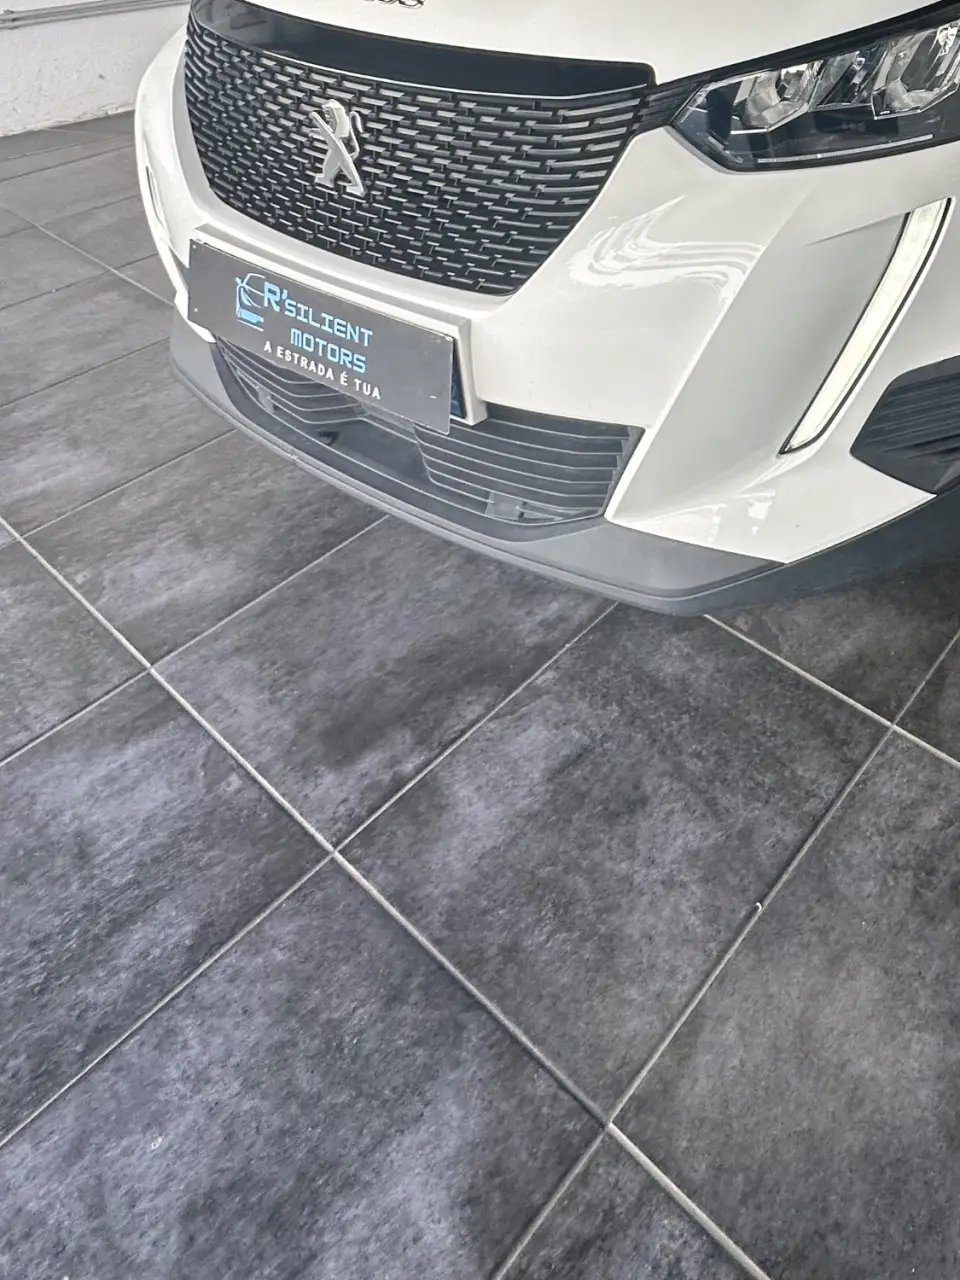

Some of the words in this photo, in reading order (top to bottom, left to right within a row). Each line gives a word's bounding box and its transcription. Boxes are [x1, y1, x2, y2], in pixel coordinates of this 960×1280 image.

[263, 281, 373, 347] R'SILIENT
[263, 340, 273, 353] A
[276, 346, 334, 381] ESTRADA
[340, 369, 349, 386] É
[354, 378, 381, 400] TUA
[290, 327, 367, 374] MOTORS
